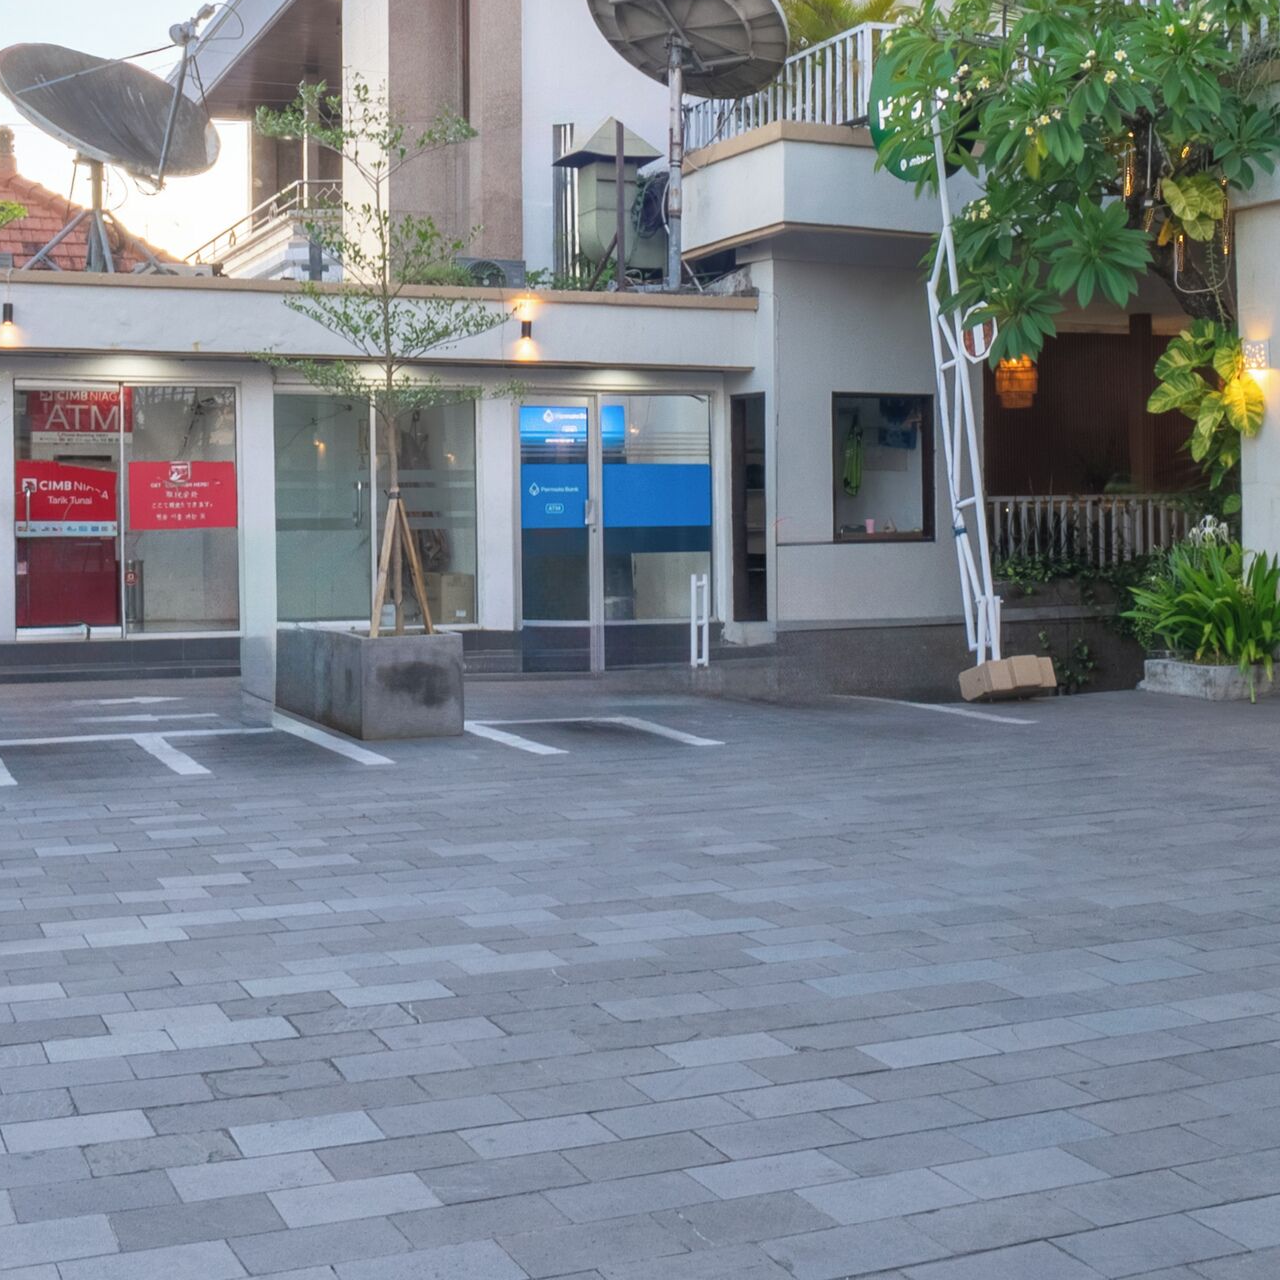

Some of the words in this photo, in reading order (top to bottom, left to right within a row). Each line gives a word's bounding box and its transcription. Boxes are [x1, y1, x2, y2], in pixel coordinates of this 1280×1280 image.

[56, 391, 88, 401] CIMB
[44, 404, 120, 430] ATM
[39, 481, 72, 491] CIMB
[48, 495, 68, 505] Tarik
[70, 495, 93, 505] Tunai
